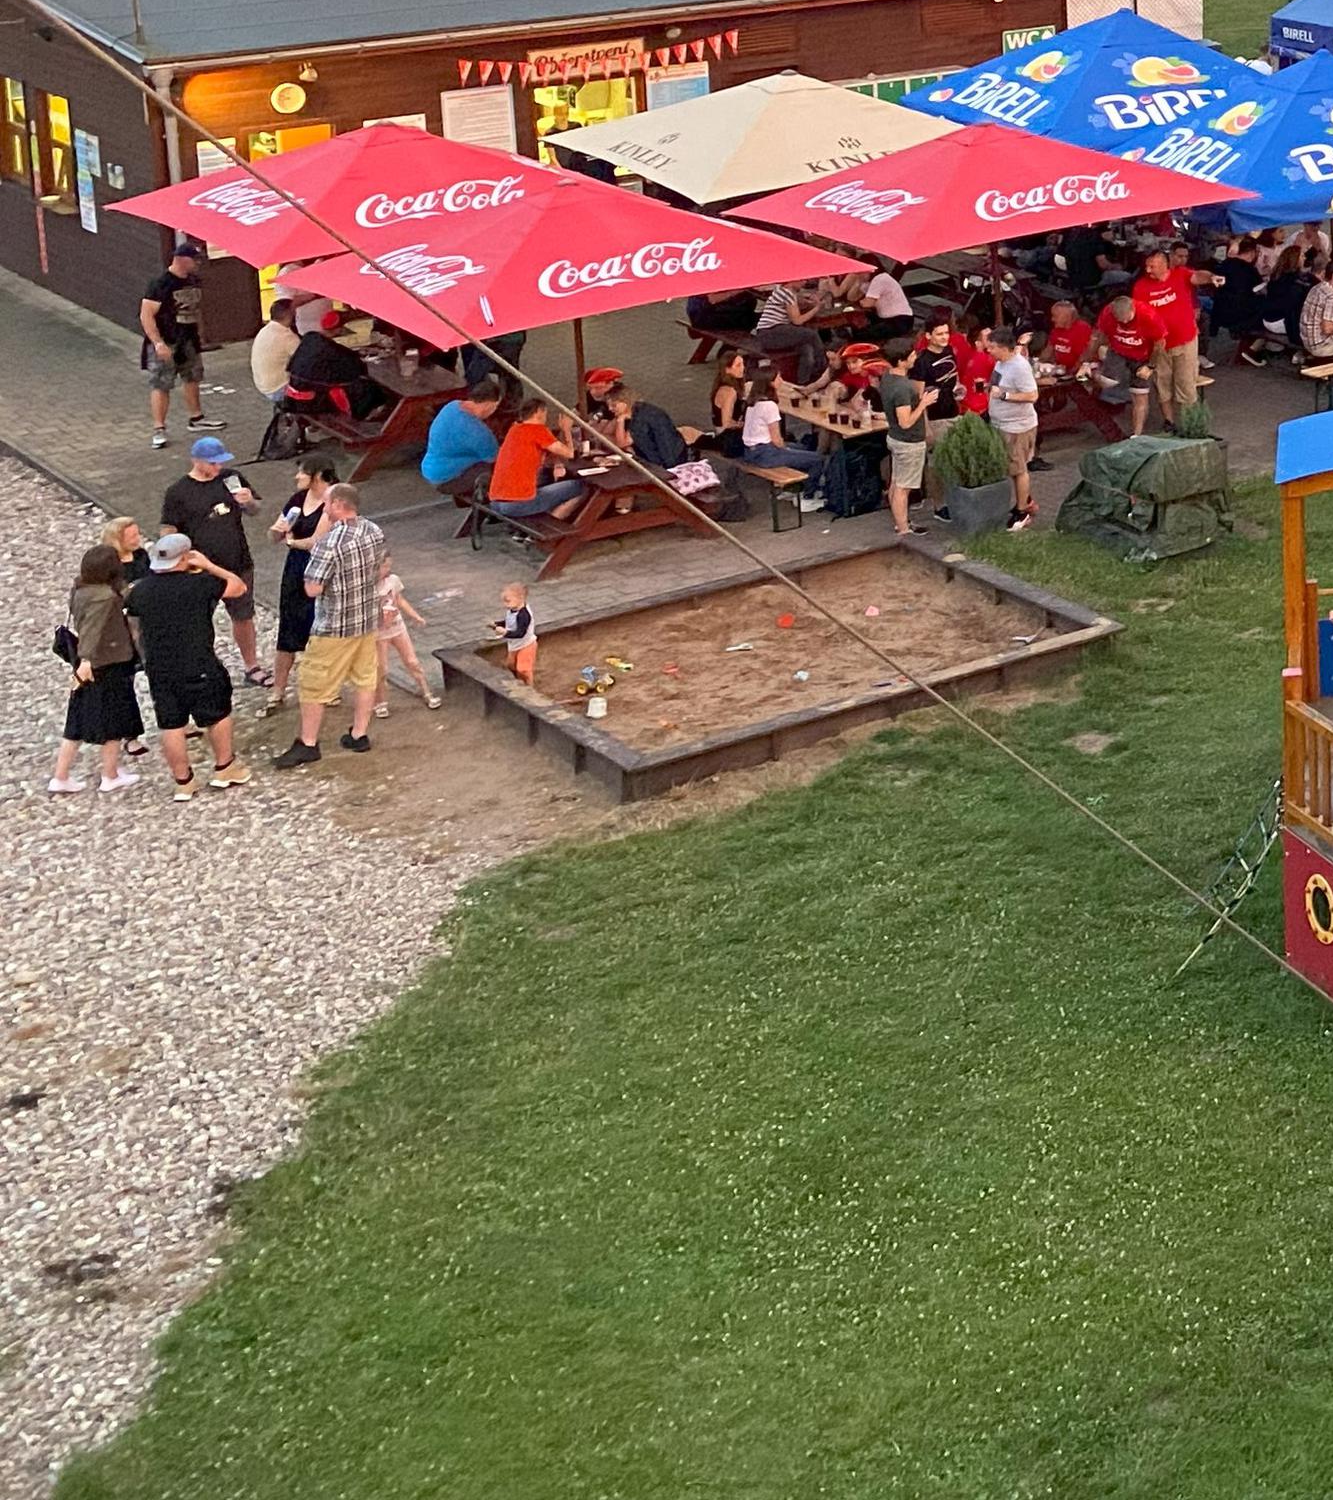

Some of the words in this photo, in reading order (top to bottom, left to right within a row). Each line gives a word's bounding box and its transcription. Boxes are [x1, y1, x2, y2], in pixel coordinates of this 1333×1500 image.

[1006, 30, 1040, 50] WC
[1282, 26, 1315, 45] BIRELL
[608, 141, 678, 172] KINLEY
[974, 169, 1130, 222] Coca-Cola
[538, 236, 723, 299] Coca-Cola
